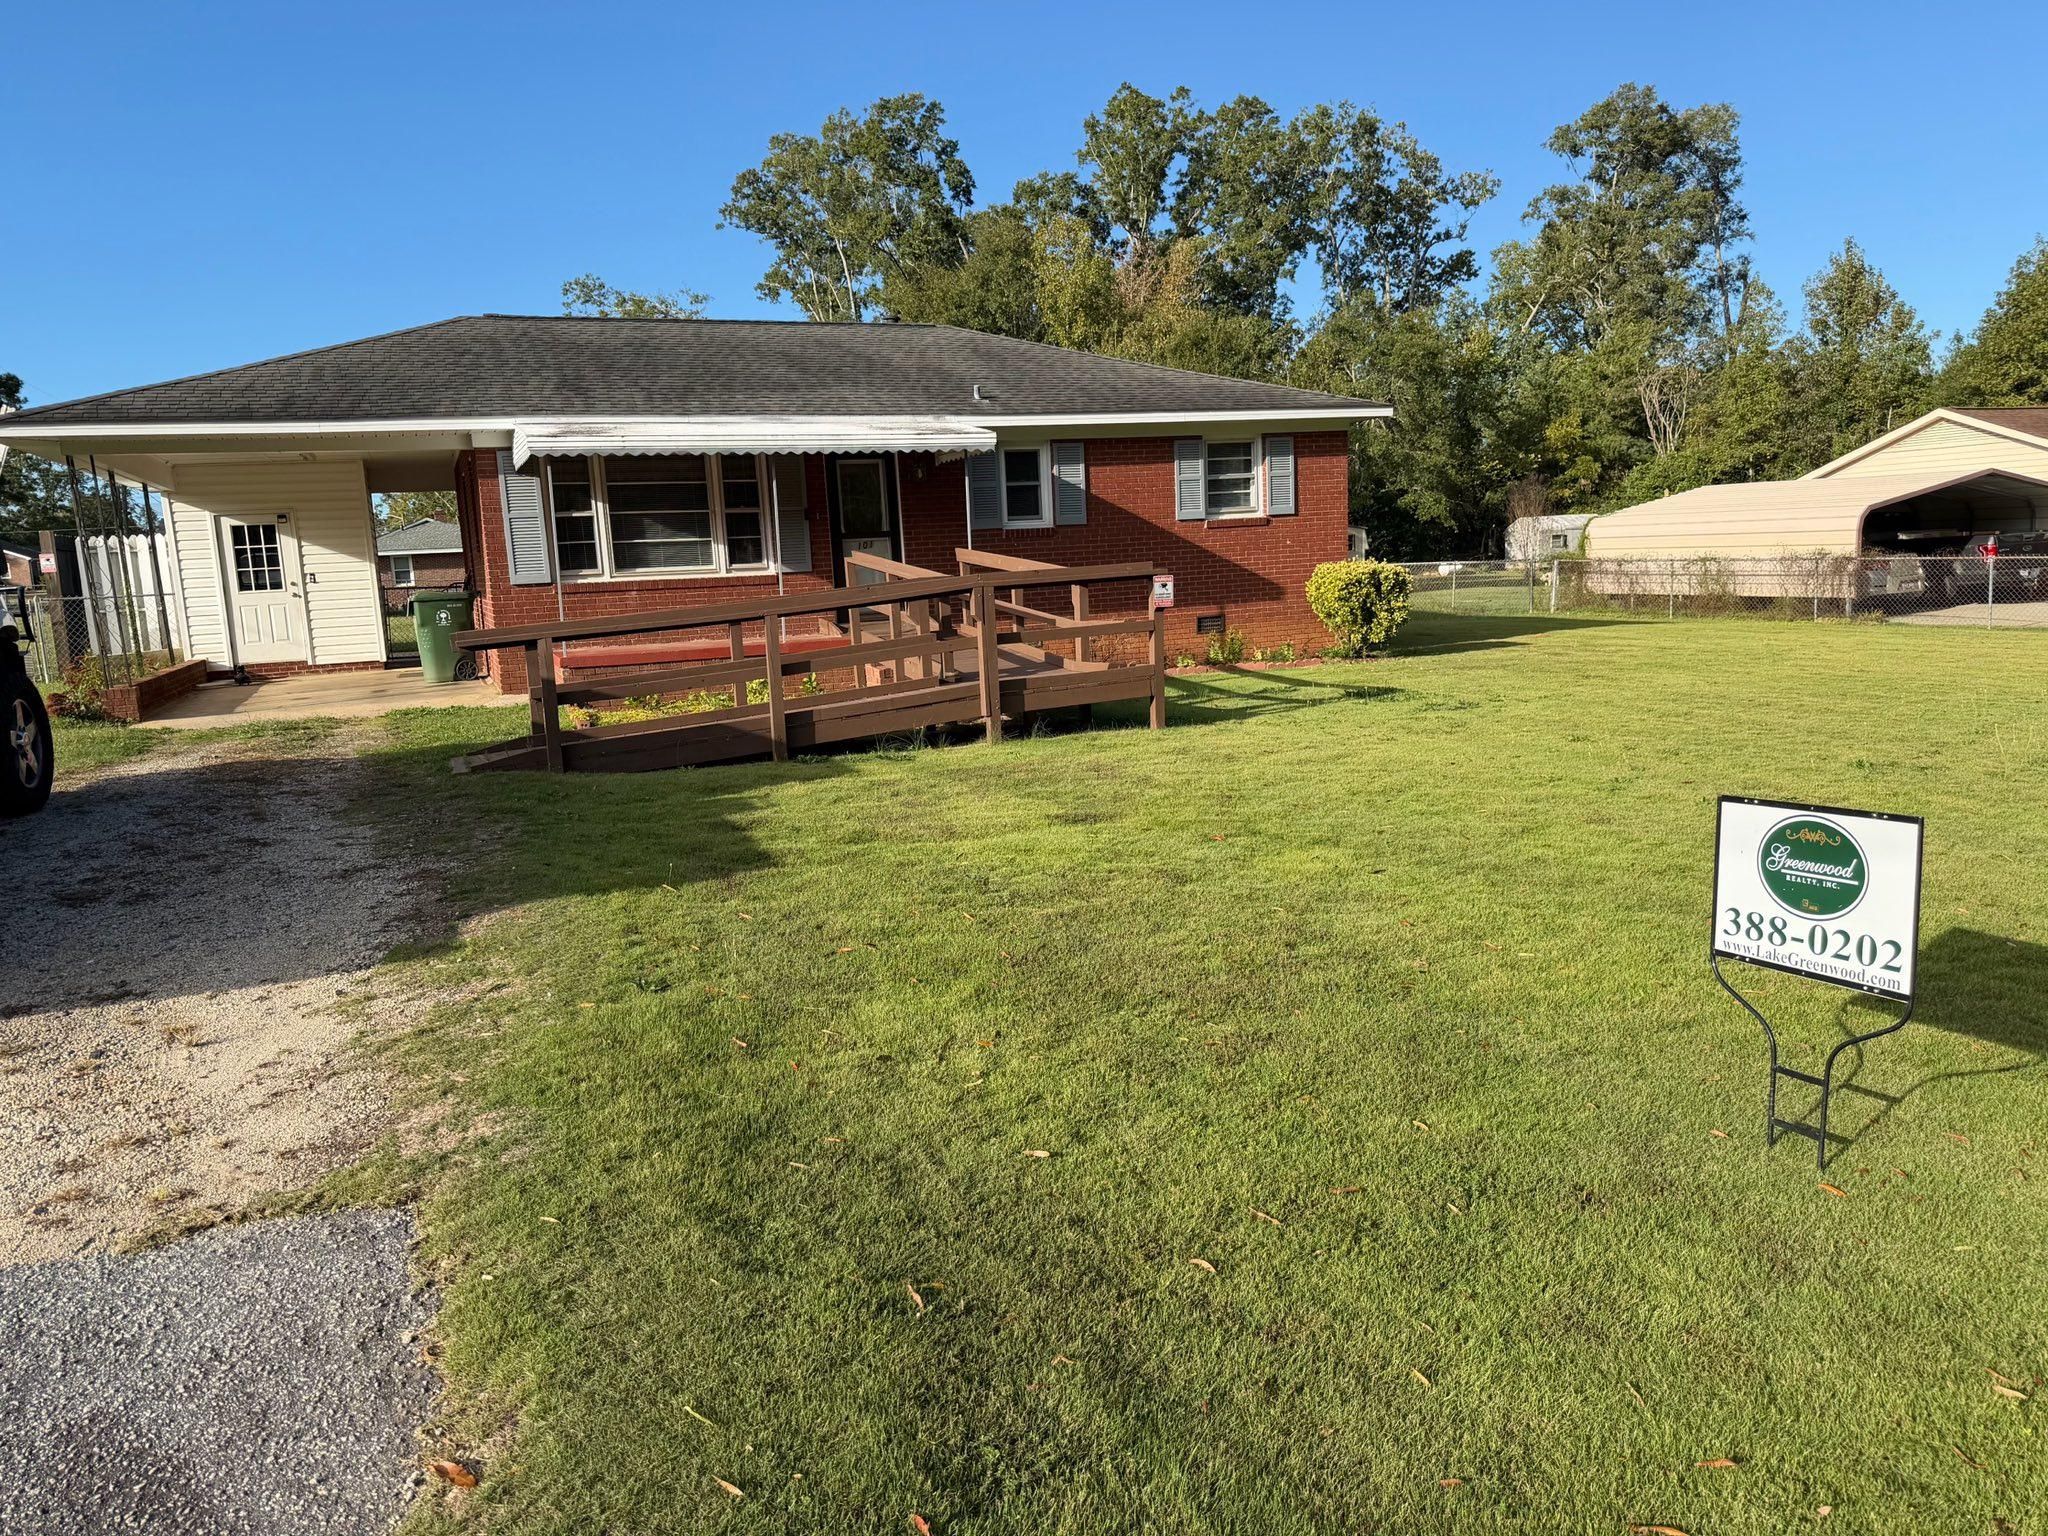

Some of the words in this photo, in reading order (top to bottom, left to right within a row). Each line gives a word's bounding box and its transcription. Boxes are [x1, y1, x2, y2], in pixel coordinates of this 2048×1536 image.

[1766, 843, 1857, 878] Greenwood
[1785, 875, 1820, 887] REALTY,
[1822, 881, 1840, 890] INC.
[1722, 907, 1903, 973] 388-0202
[1722, 940, 1901, 990] www.LakeGreenwood.com
